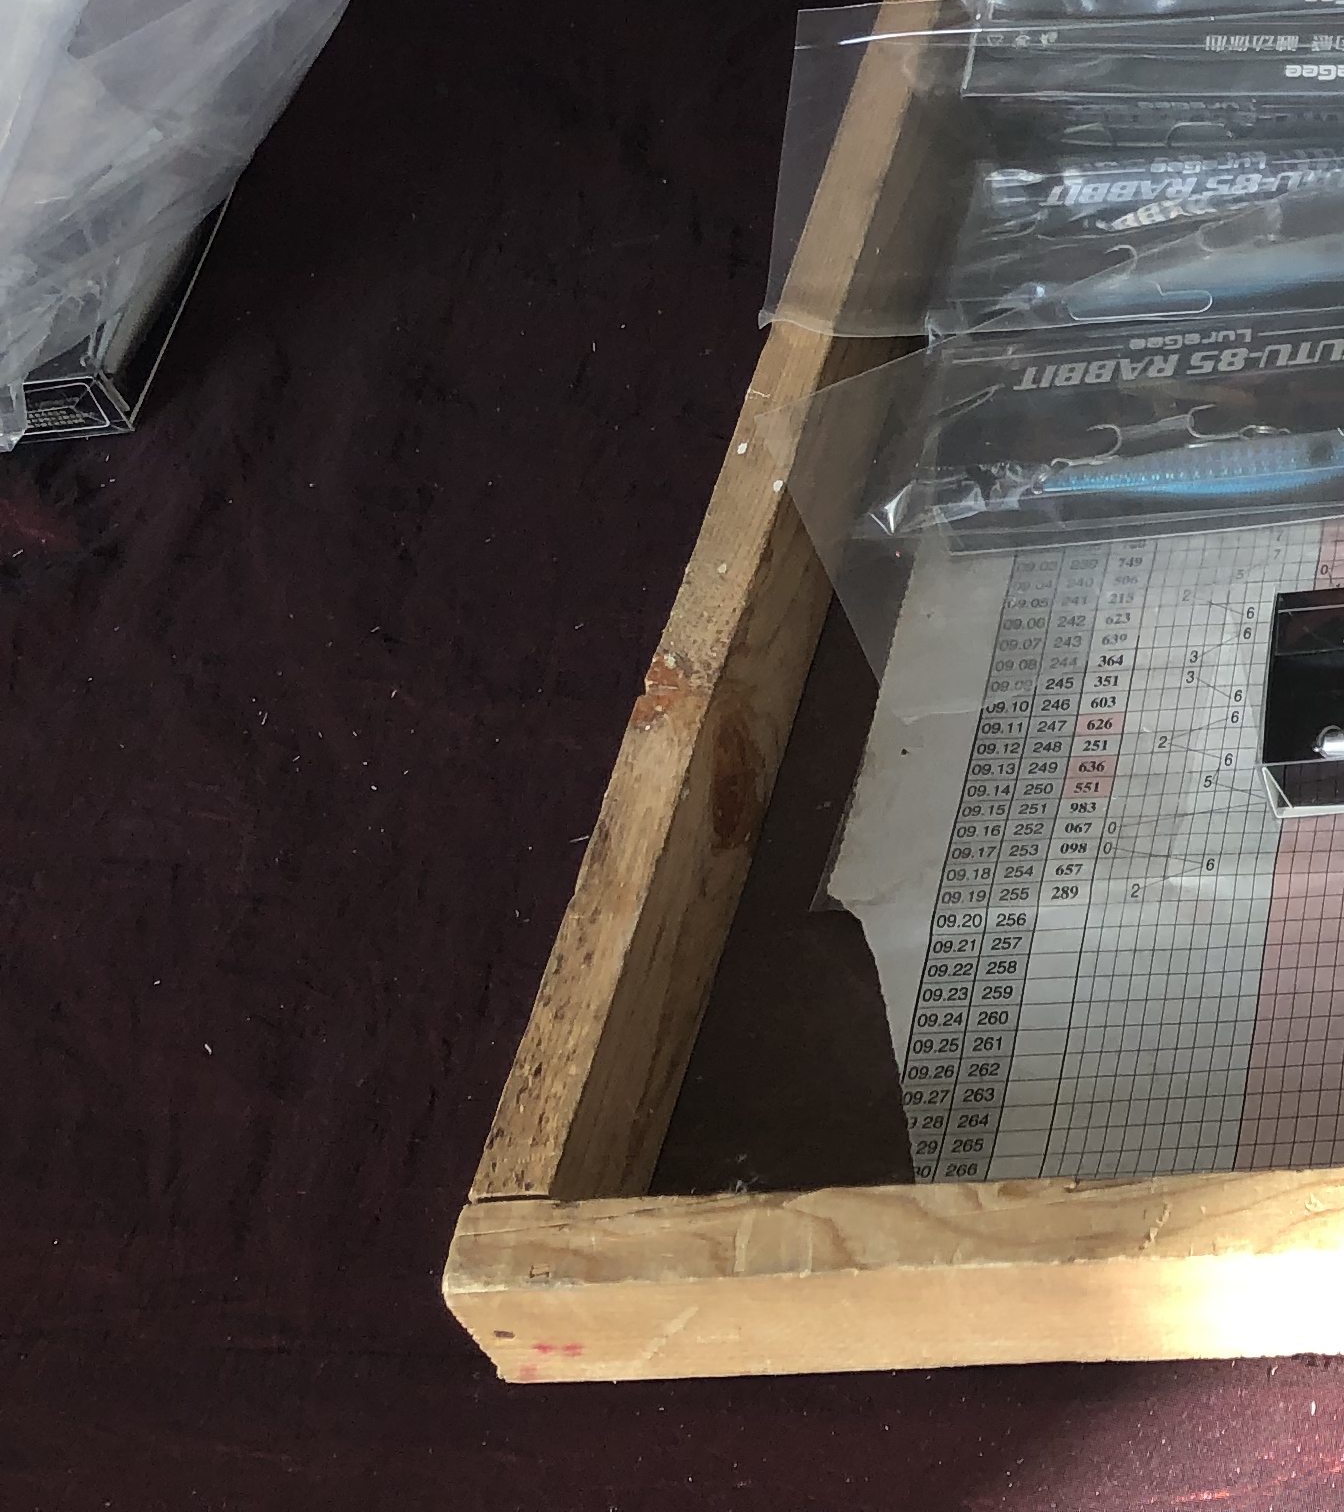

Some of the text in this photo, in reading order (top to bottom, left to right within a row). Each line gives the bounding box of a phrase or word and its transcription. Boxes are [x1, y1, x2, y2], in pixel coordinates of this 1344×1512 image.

[1129, 328, 1252, 351] LureGee
[1012, 352, 1179, 391] RABBIT
[1041, 699, 1071, 711] 246
[981, 720, 1067, 735] 09.11 247
[977, 741, 1062, 755] 09.12 248
[972, 762, 1058, 775] 09.13 249
[967, 783, 1054, 797] 09.14 250
[962, 803, 1048, 818] 09.15 251
[956, 823, 1045, 838] 09.16 252
[951, 844, 1039, 860] 09.17 253
[946, 866, 1034, 881] 09.18 254
[941, 888, 1030, 905] 09.19 255
[936, 913, 1027, 928] 09.20 256
[932, 936, 1023, 954] 09.21 257
[927, 960, 1017, 977] 09.22 258
[922, 985, 1013, 1002] 09.23 259
[917, 1010, 1009, 1027] 09.24 260
[912, 1037, 1003, 1054] 09.25 261
[908, 1063, 1000, 1079] 09.26 262
[902, 1088, 995, 1105] 09.27 263
[957, 1114, 990, 1128] 264
[951, 1139, 983, 1153] 265
[945, 1164, 978, 1177] 266
